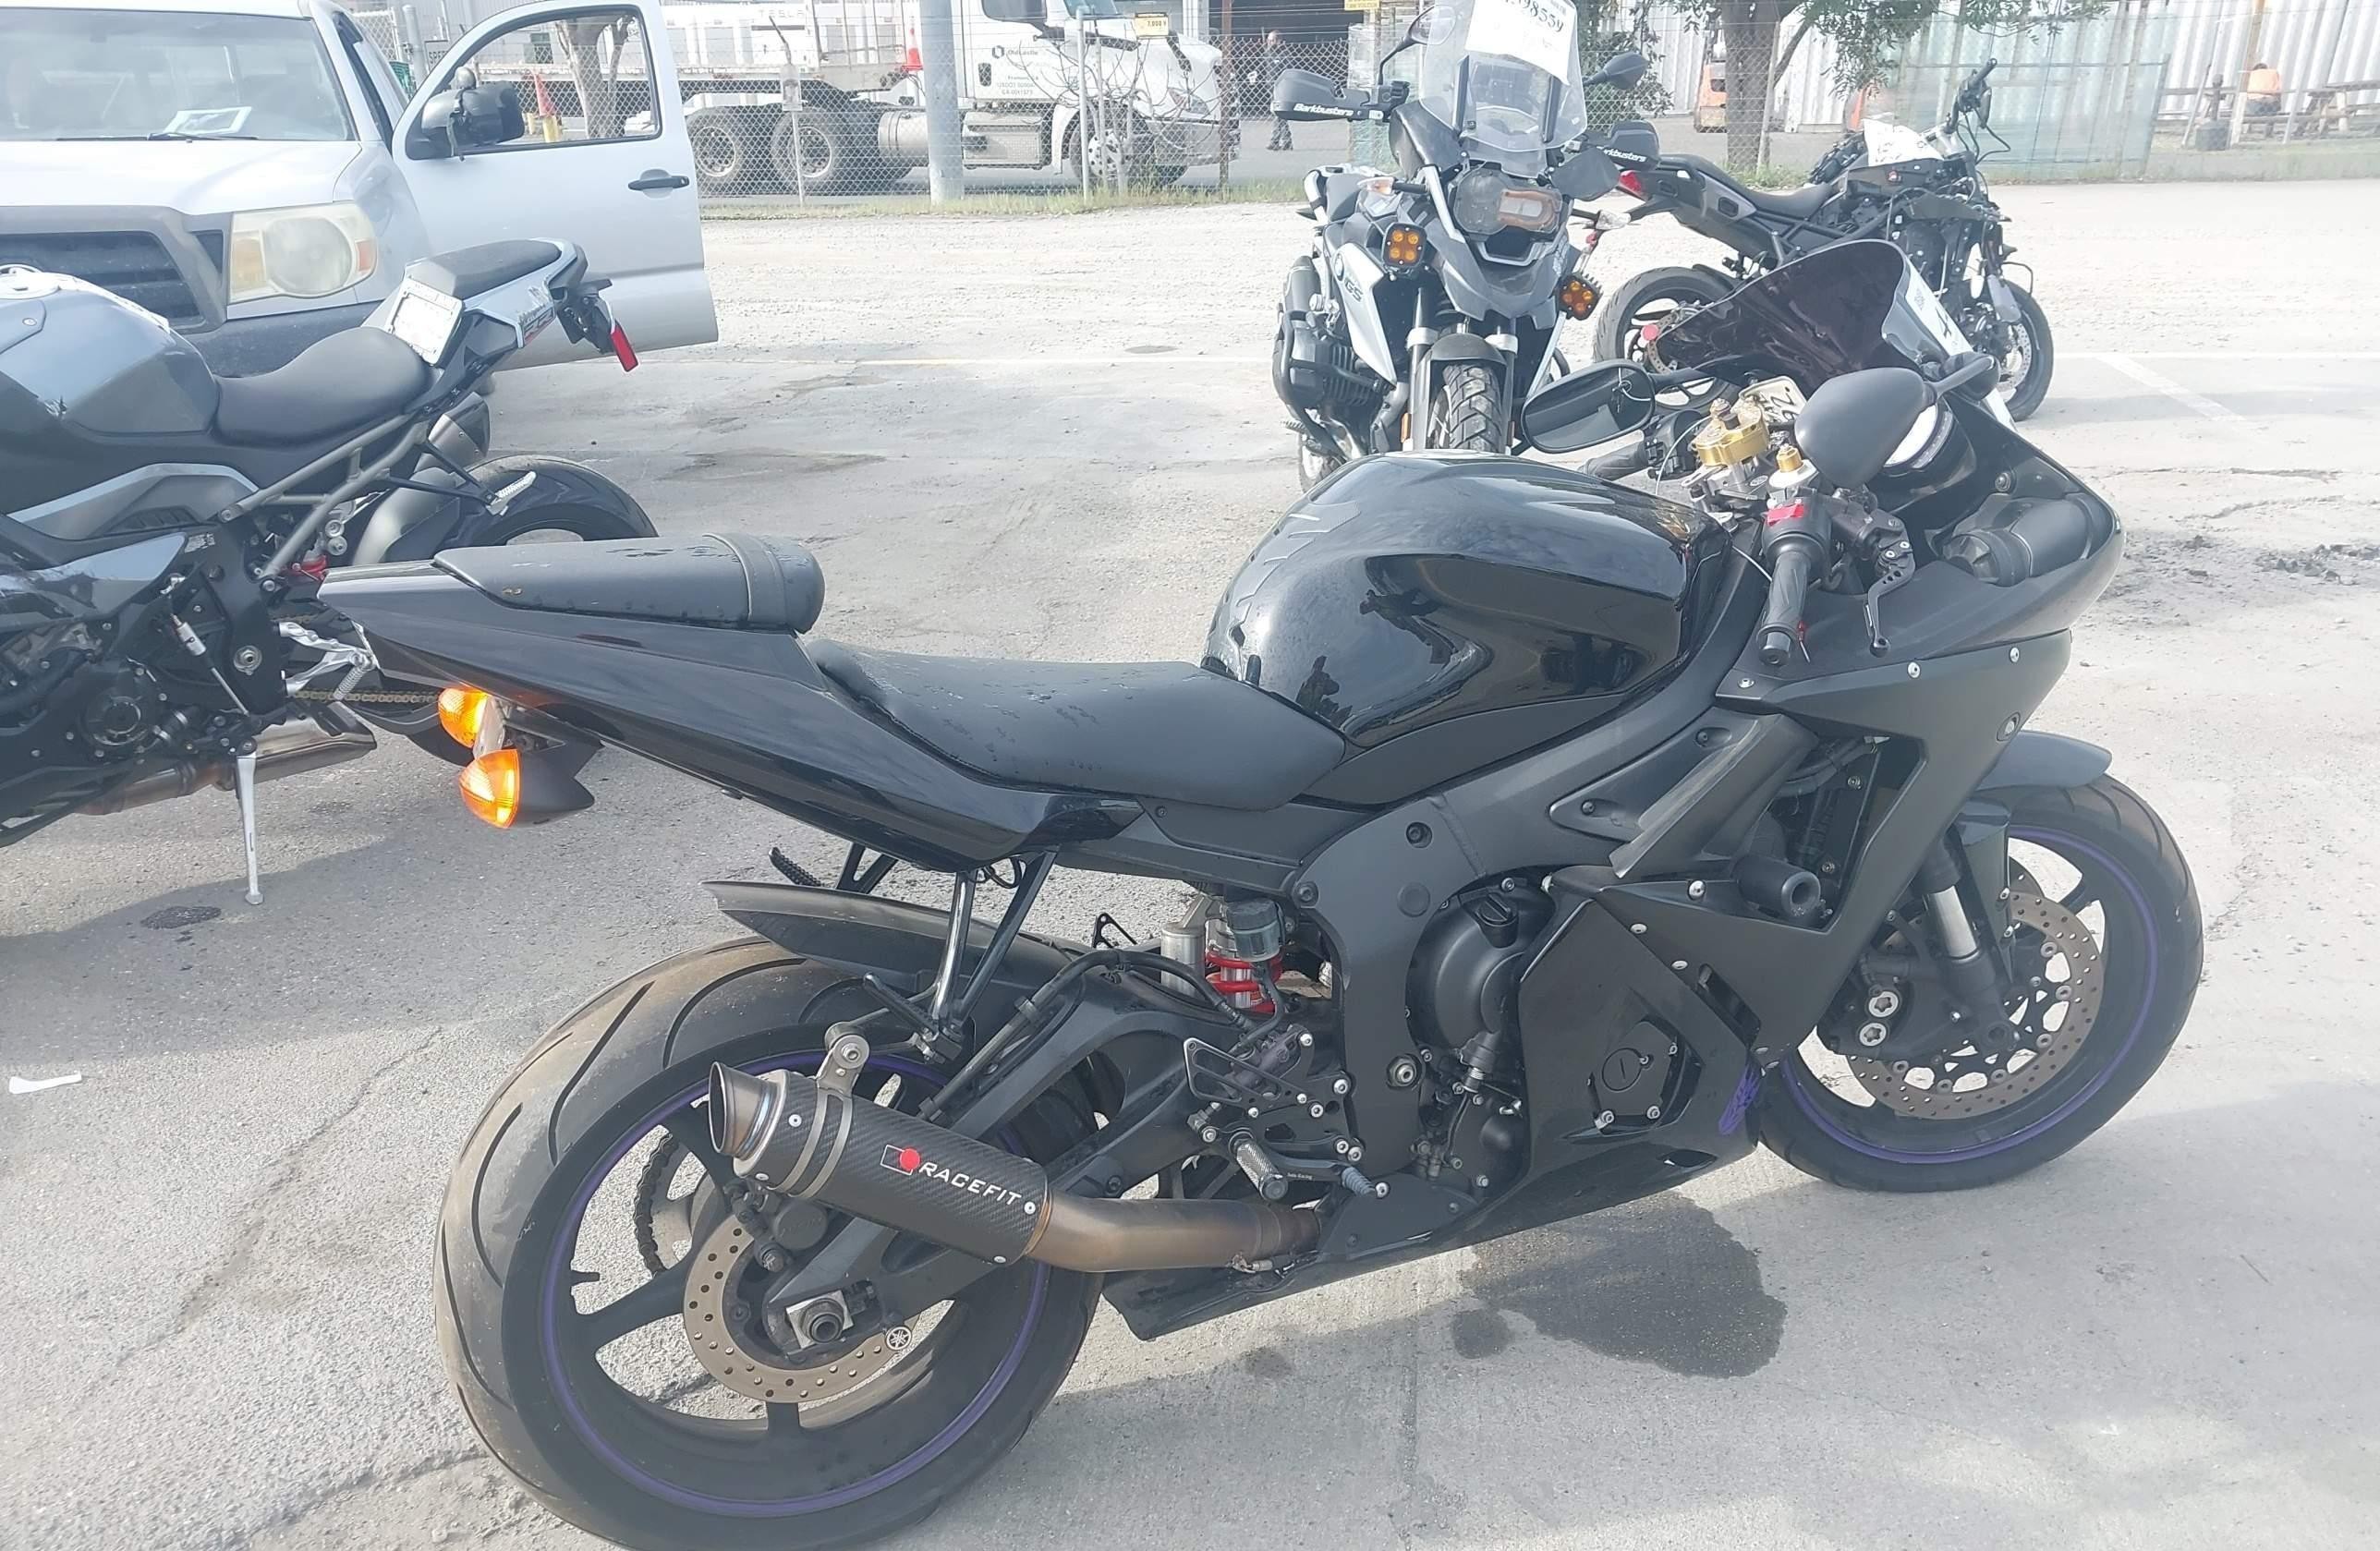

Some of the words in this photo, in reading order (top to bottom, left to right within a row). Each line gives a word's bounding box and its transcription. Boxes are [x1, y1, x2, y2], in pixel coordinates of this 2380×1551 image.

[1293, 103, 1354, 116] Barkbusters
[1345, 279, 1364, 302] GS
[918, 1161, 1022, 1206] RACEFIT
